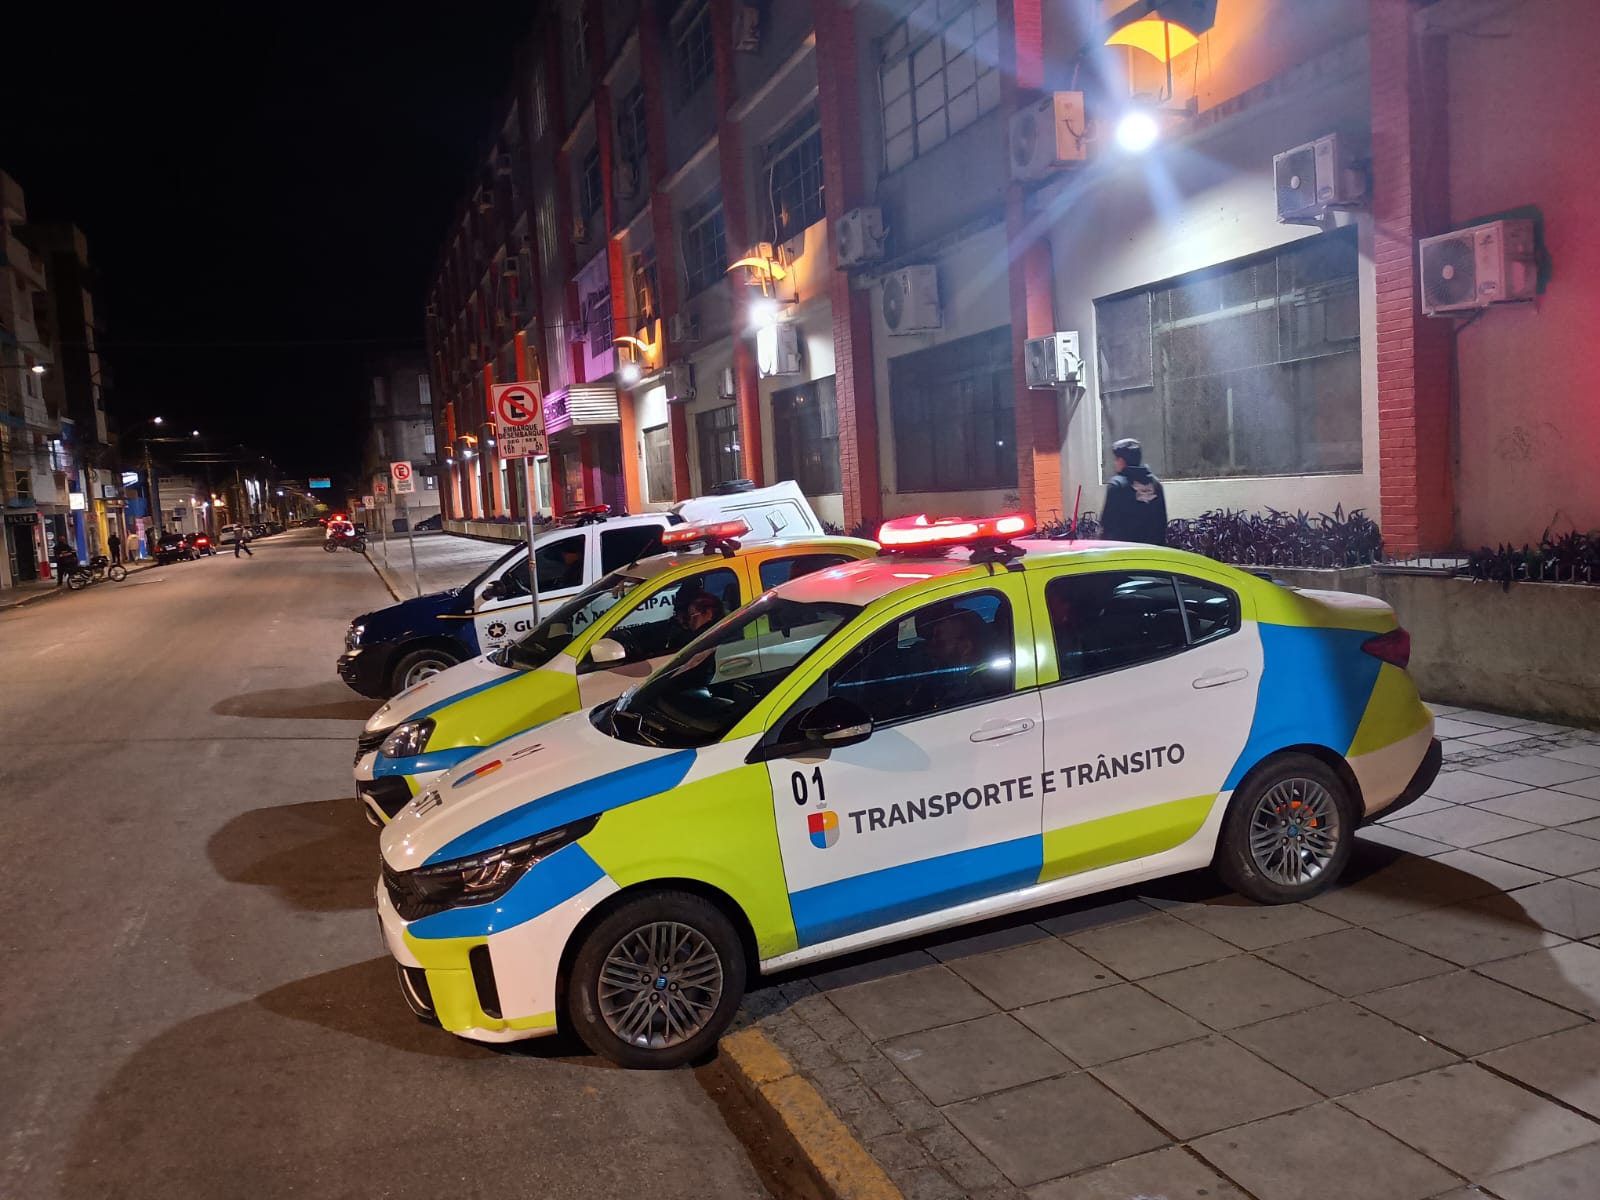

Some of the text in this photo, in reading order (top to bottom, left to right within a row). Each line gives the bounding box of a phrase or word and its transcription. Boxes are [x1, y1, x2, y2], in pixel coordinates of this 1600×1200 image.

[499, 430, 545, 439] DESEMBARQUE
[504, 424, 537, 432] EMBARQUE
[791, 766, 826, 806] 01
[848, 743, 1186, 834] TRANSPORTE E TRÂNSITO
